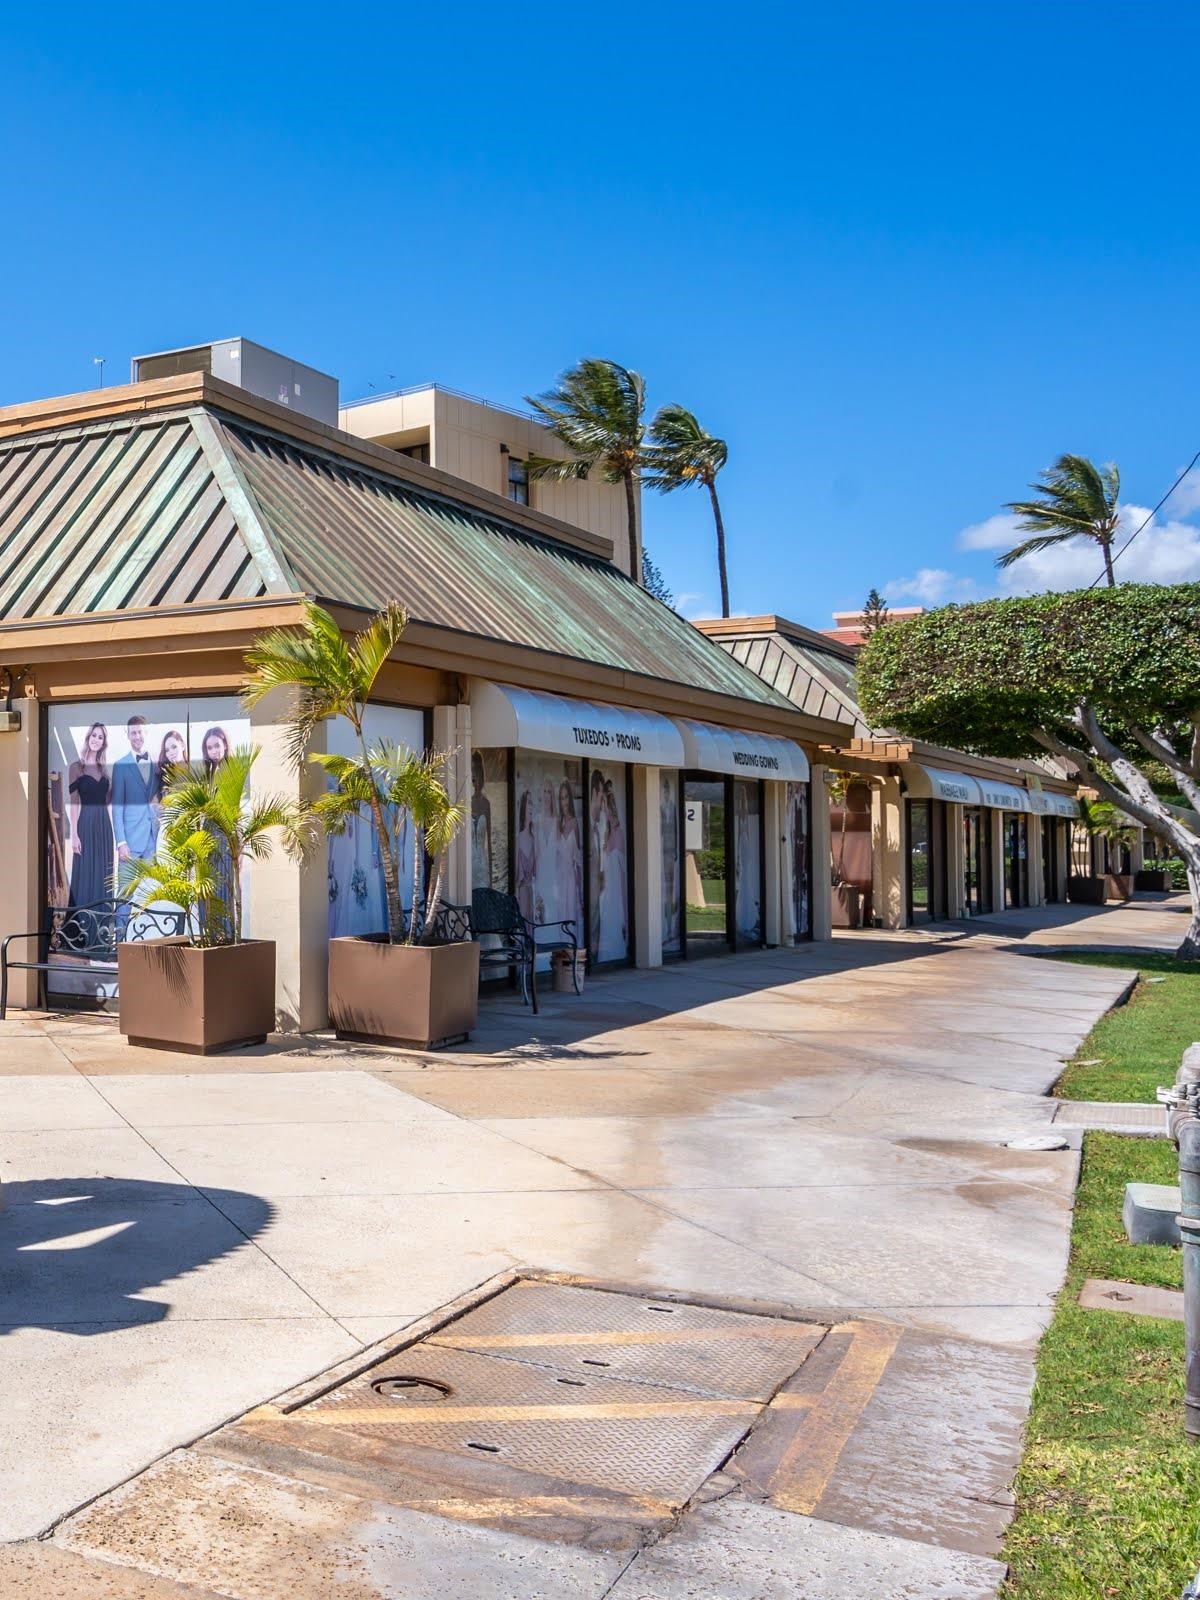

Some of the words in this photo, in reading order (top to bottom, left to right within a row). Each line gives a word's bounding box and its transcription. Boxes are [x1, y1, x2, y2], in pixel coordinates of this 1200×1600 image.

[572, 727, 609, 746] TUXEDOS
[616, 733, 641, 751] PROMS
[732, 751, 759, 767] WEDDING
[760, 755, 779, 770] GOWNS
